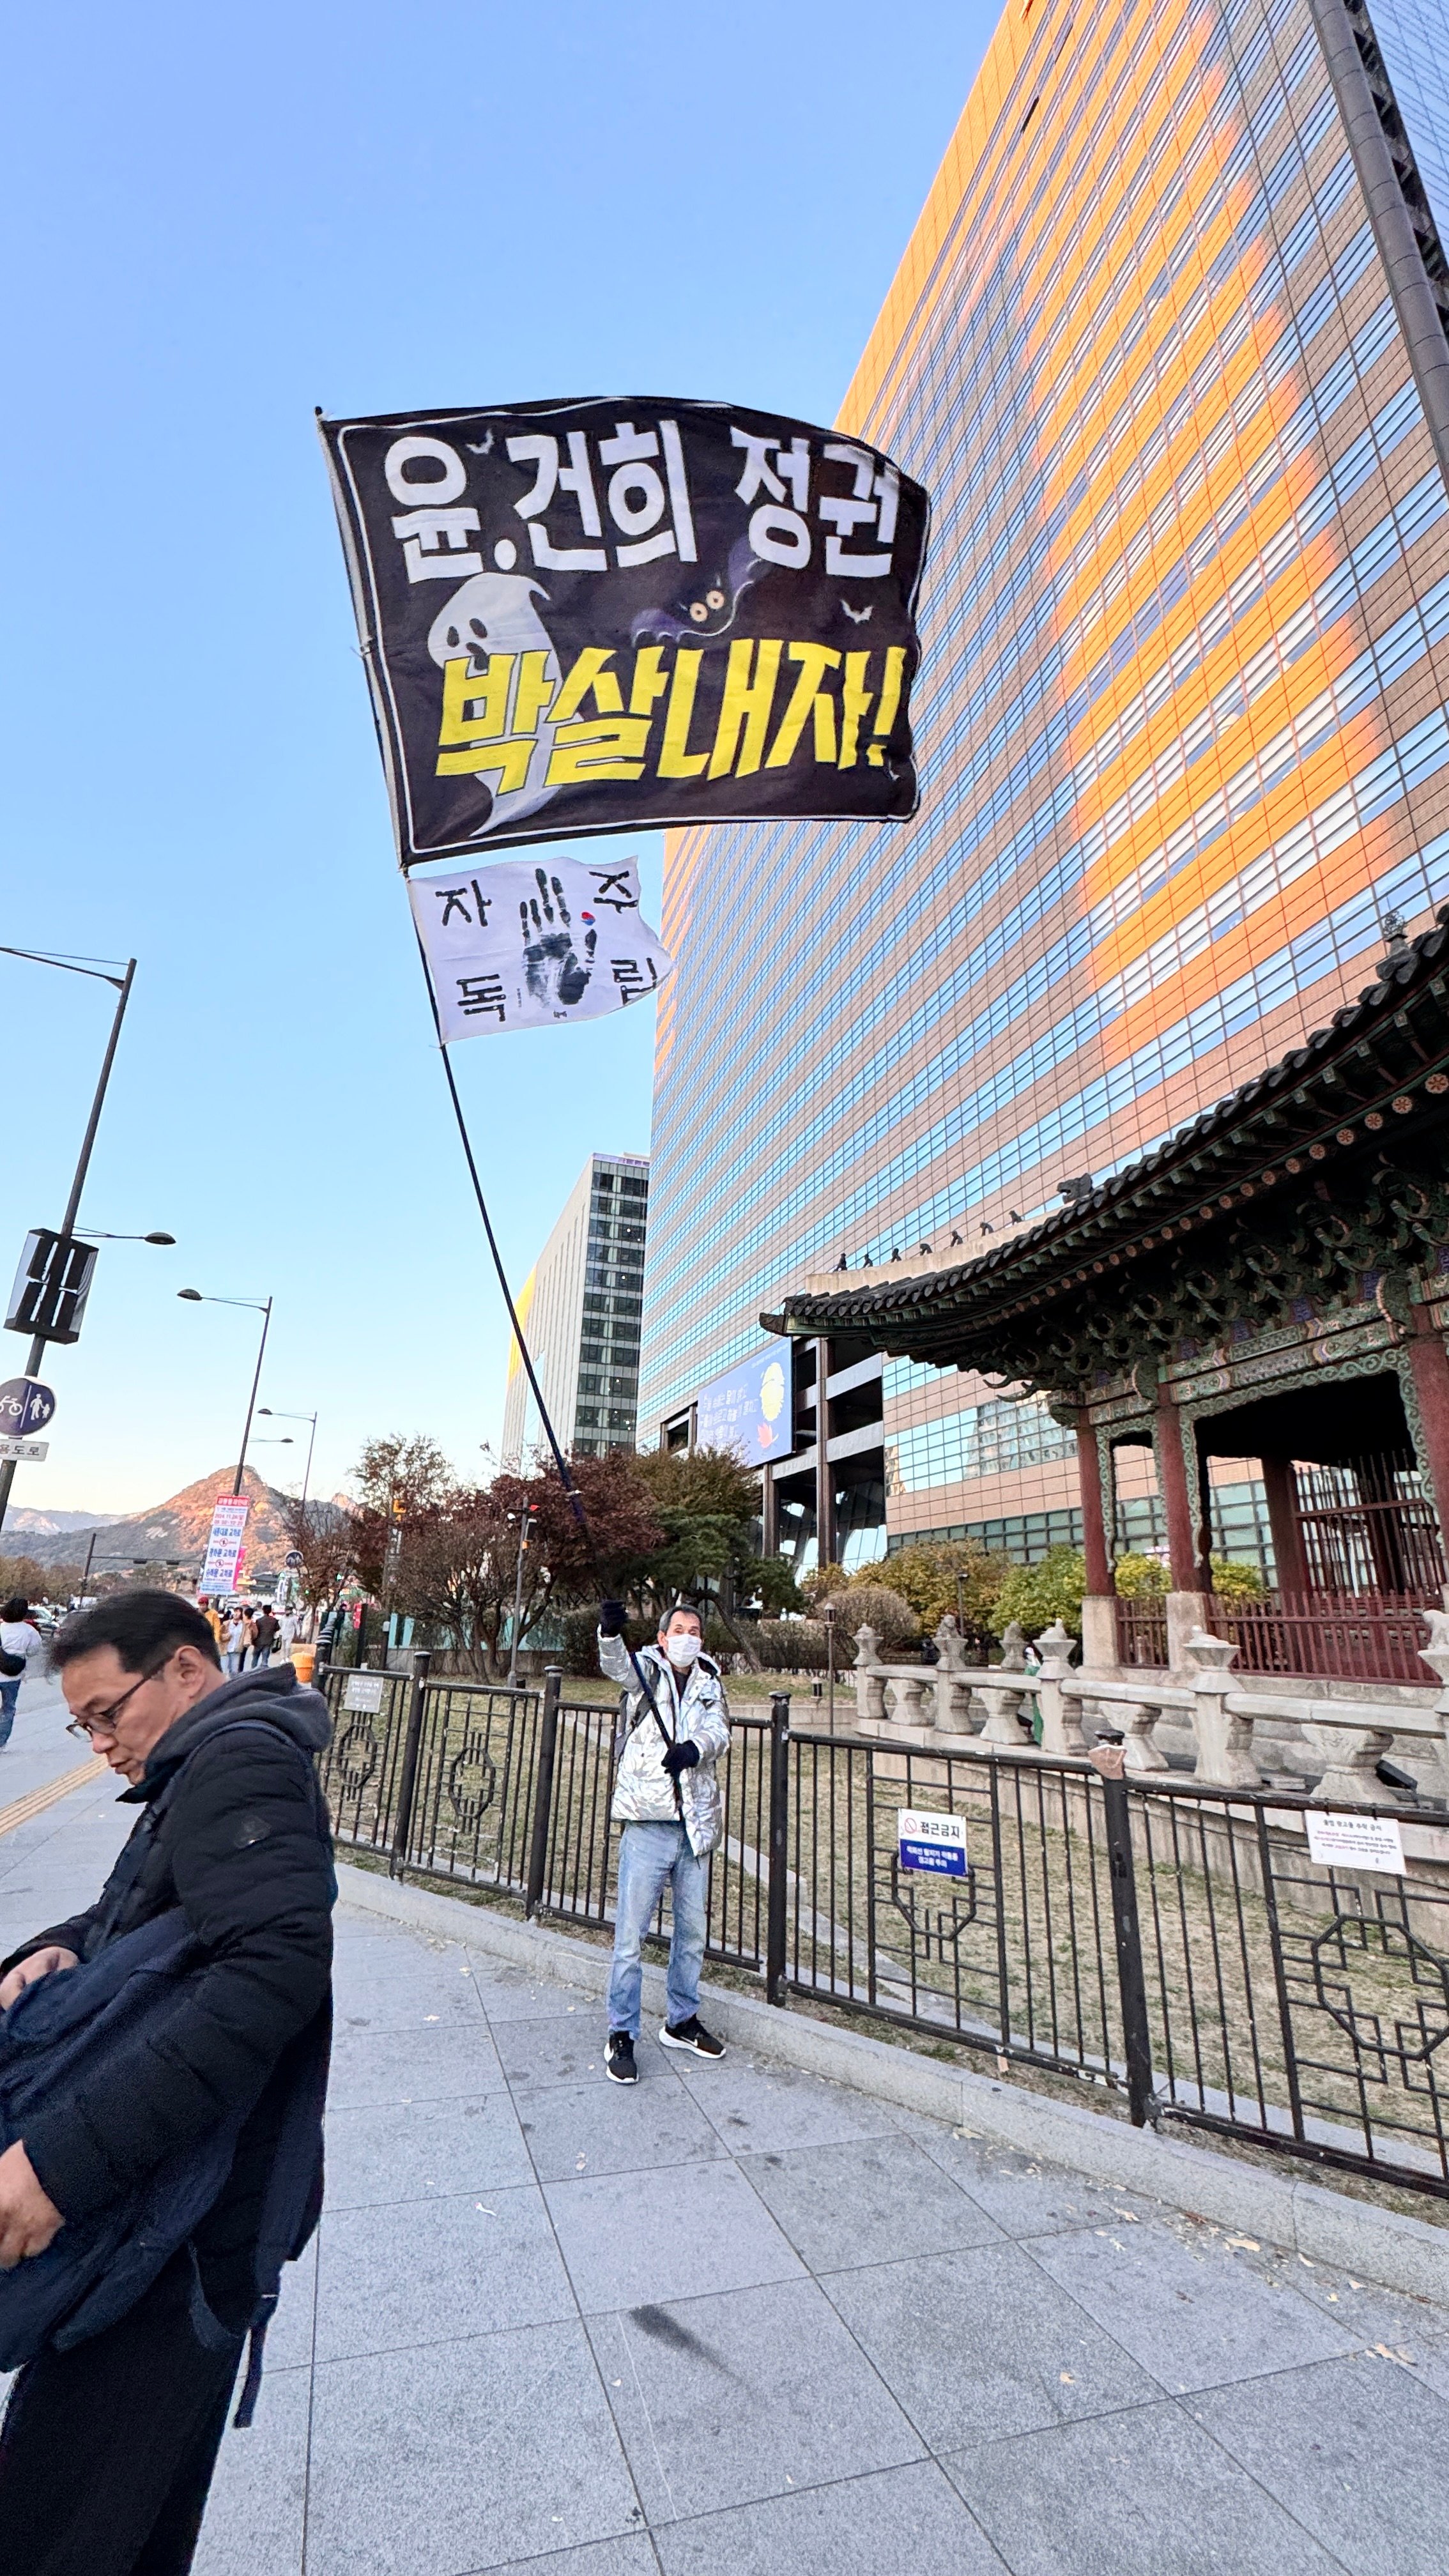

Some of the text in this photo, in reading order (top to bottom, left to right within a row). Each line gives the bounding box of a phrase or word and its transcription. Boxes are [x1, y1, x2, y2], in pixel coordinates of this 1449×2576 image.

[383, 419, 901, 585] 윤.건희 정권
[434, 639, 907, 796] 박살내자!
[435, 879, 492, 927] 자
[920, 1821, 960, 1839] 접근금지
